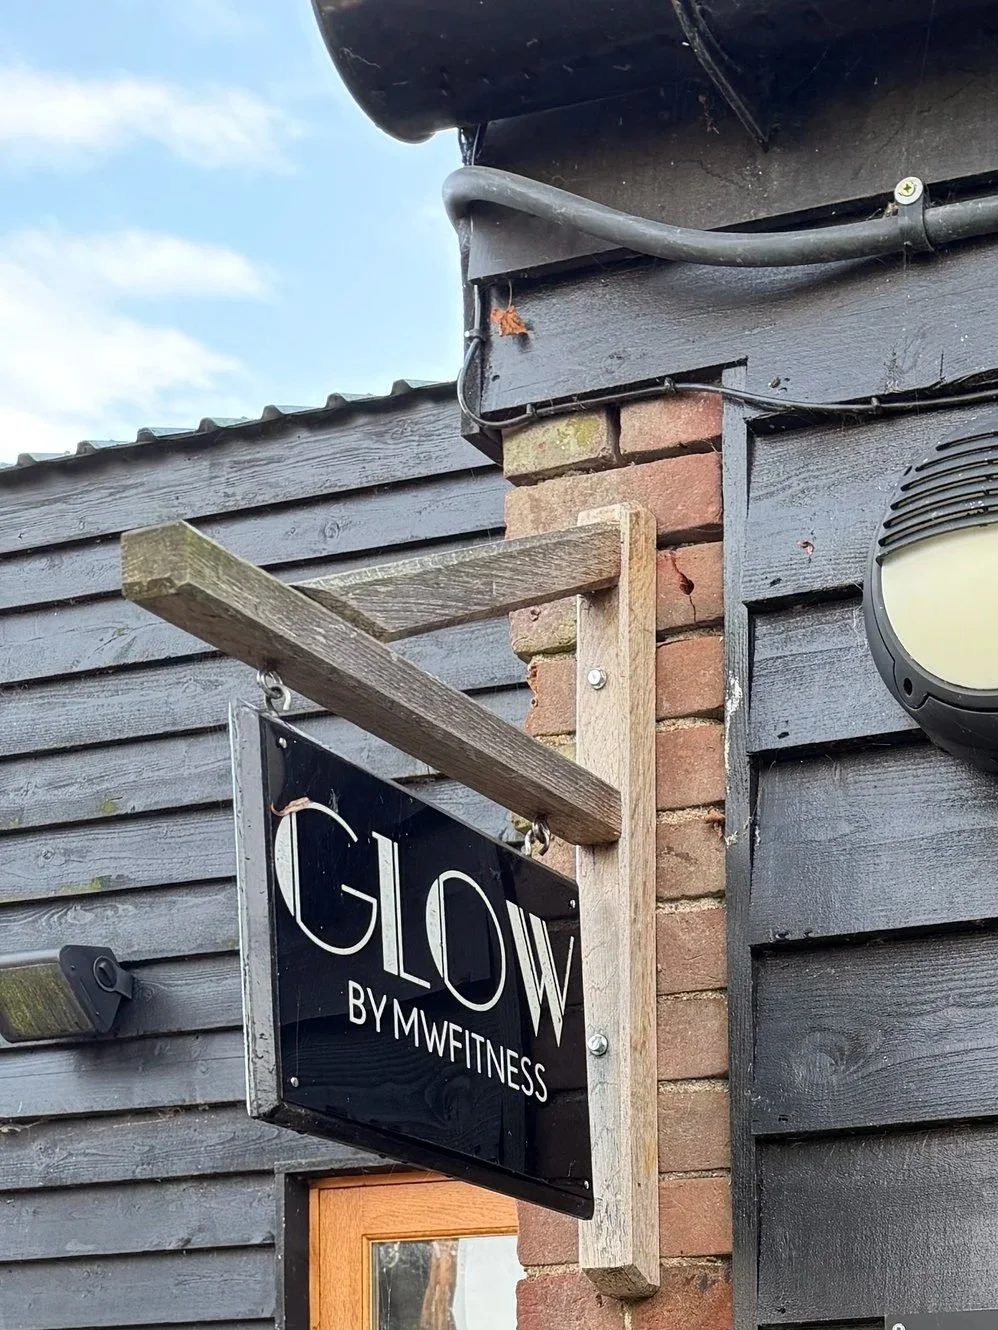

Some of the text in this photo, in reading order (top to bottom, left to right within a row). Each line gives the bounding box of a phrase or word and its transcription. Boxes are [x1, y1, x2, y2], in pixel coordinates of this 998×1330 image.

[274, 800, 575, 1047] GLOW
[348, 980, 548, 1103] BY MWFITNESS
